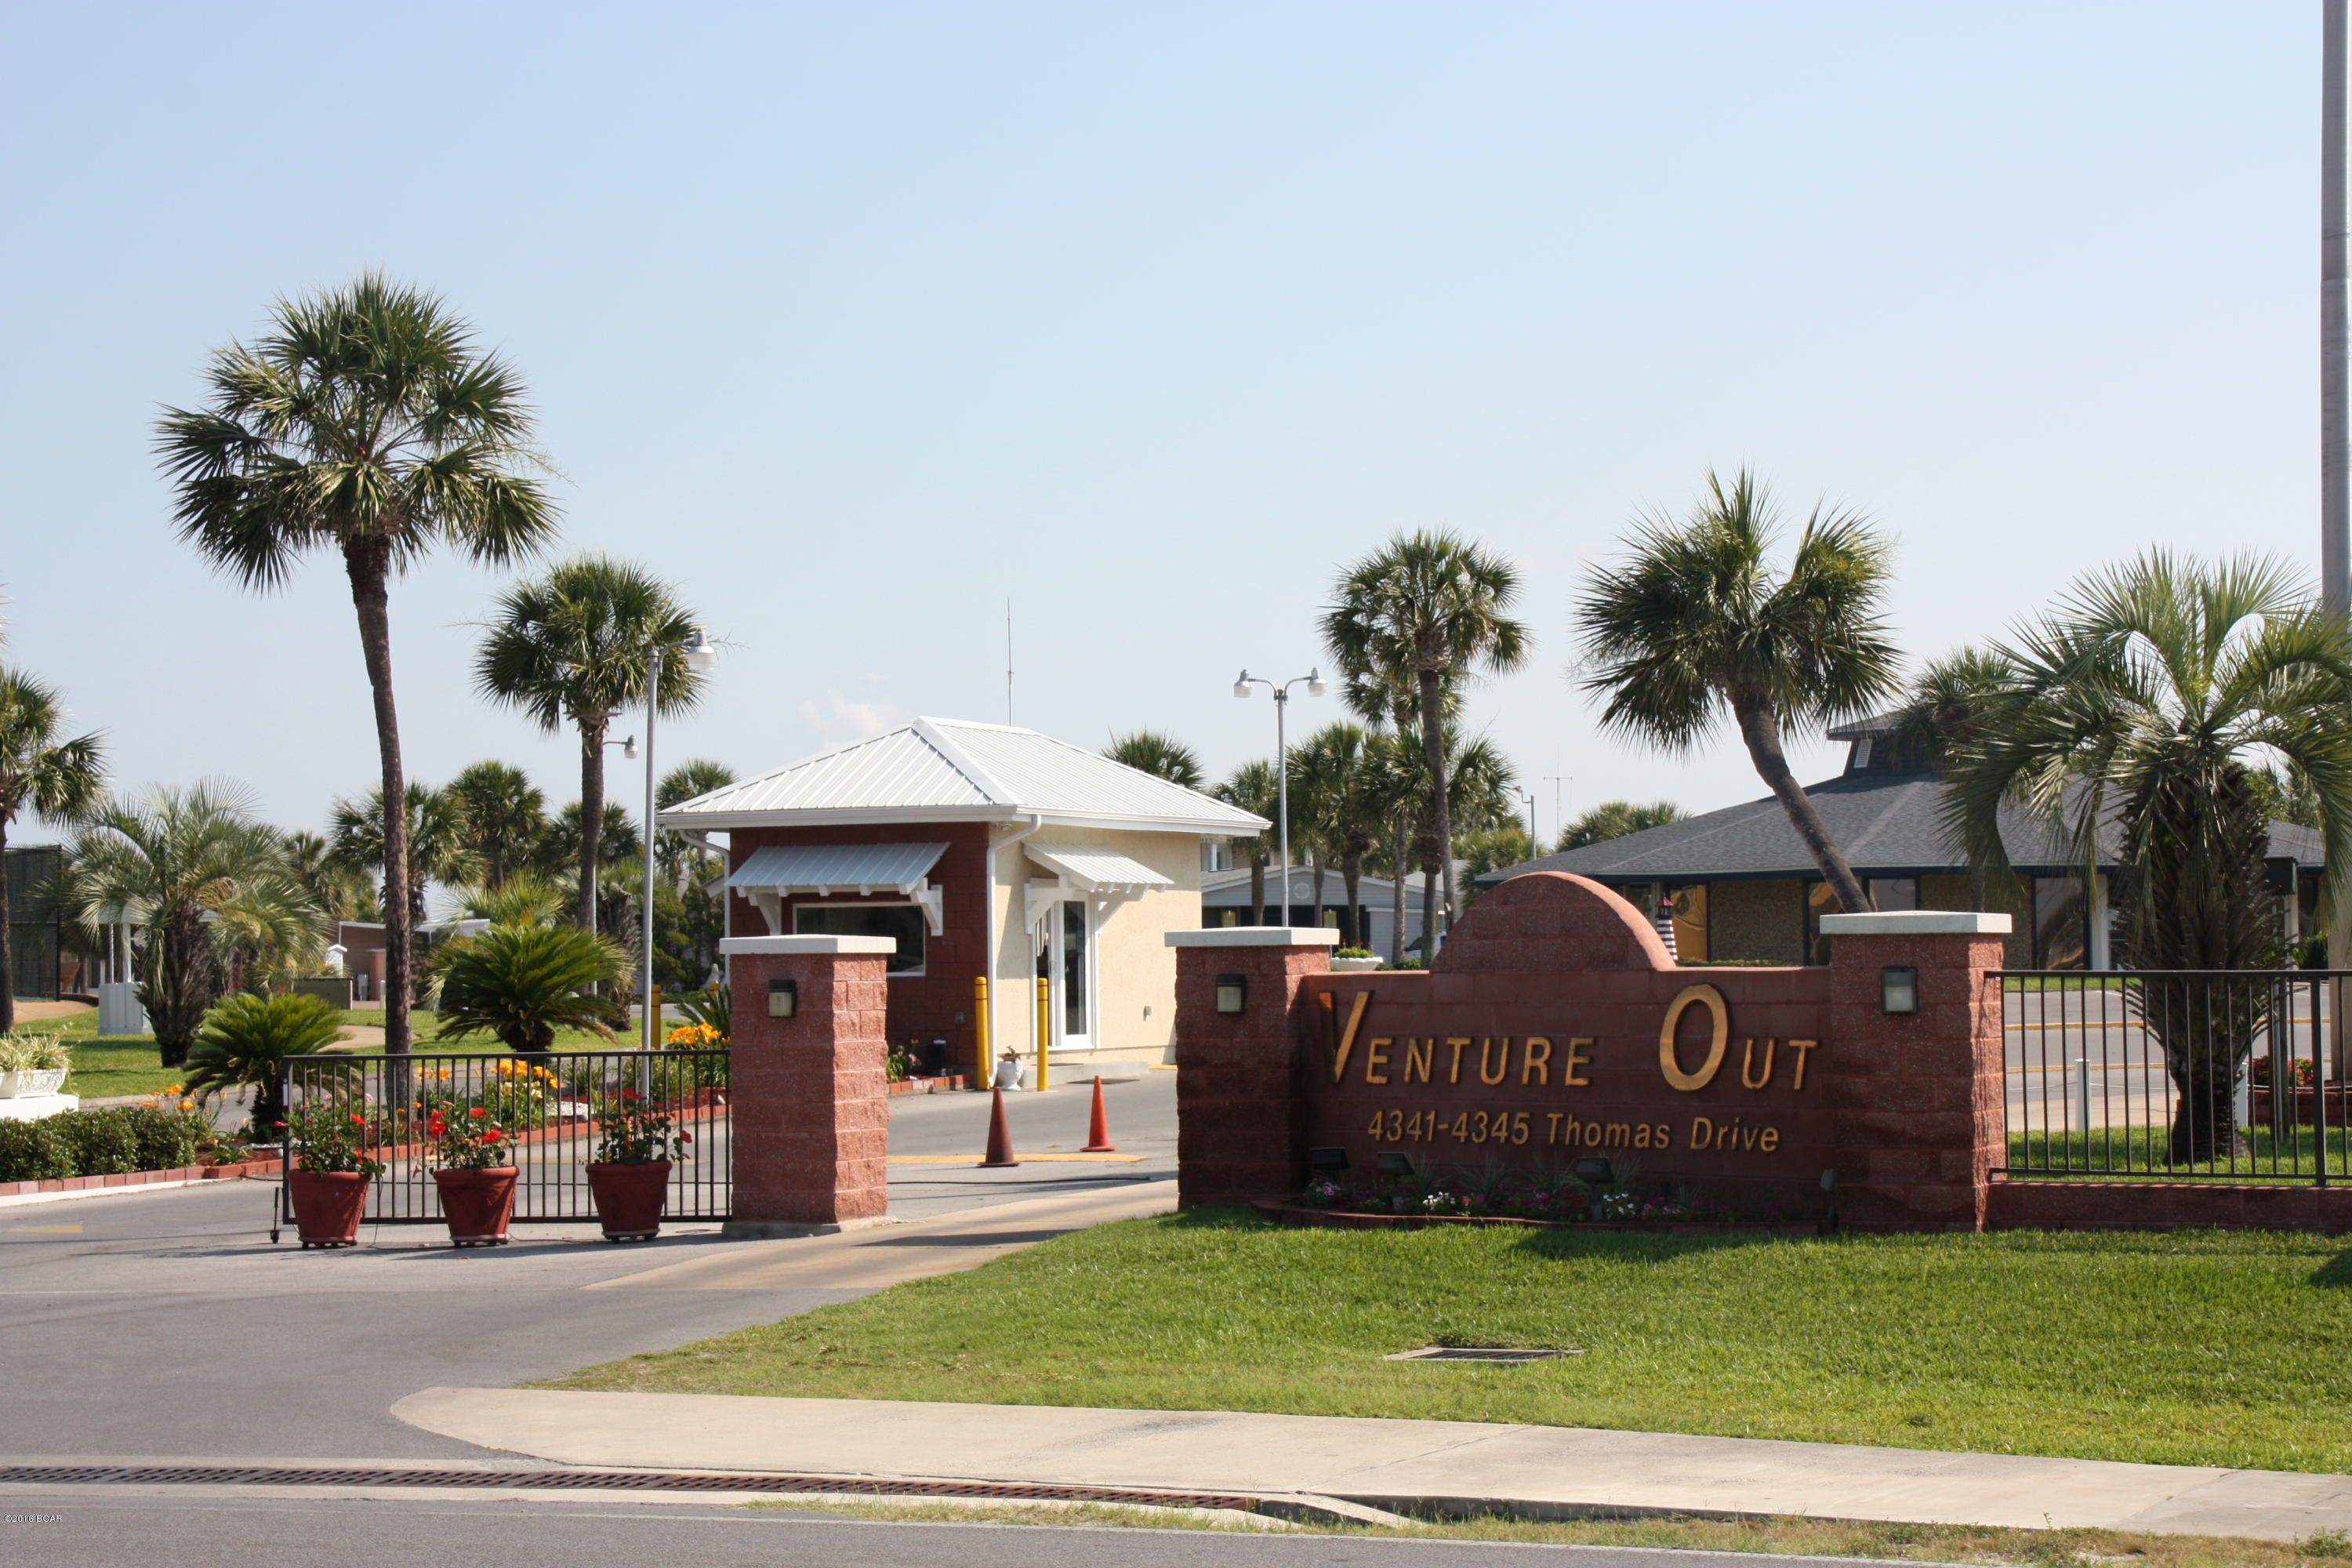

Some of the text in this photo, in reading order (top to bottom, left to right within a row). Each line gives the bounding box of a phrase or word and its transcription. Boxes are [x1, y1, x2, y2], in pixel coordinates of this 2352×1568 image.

[1319, 983, 1817, 1091] VENTURE OUT
[1367, 1109, 1780, 1152] 4341-4345 Thomas Drive
